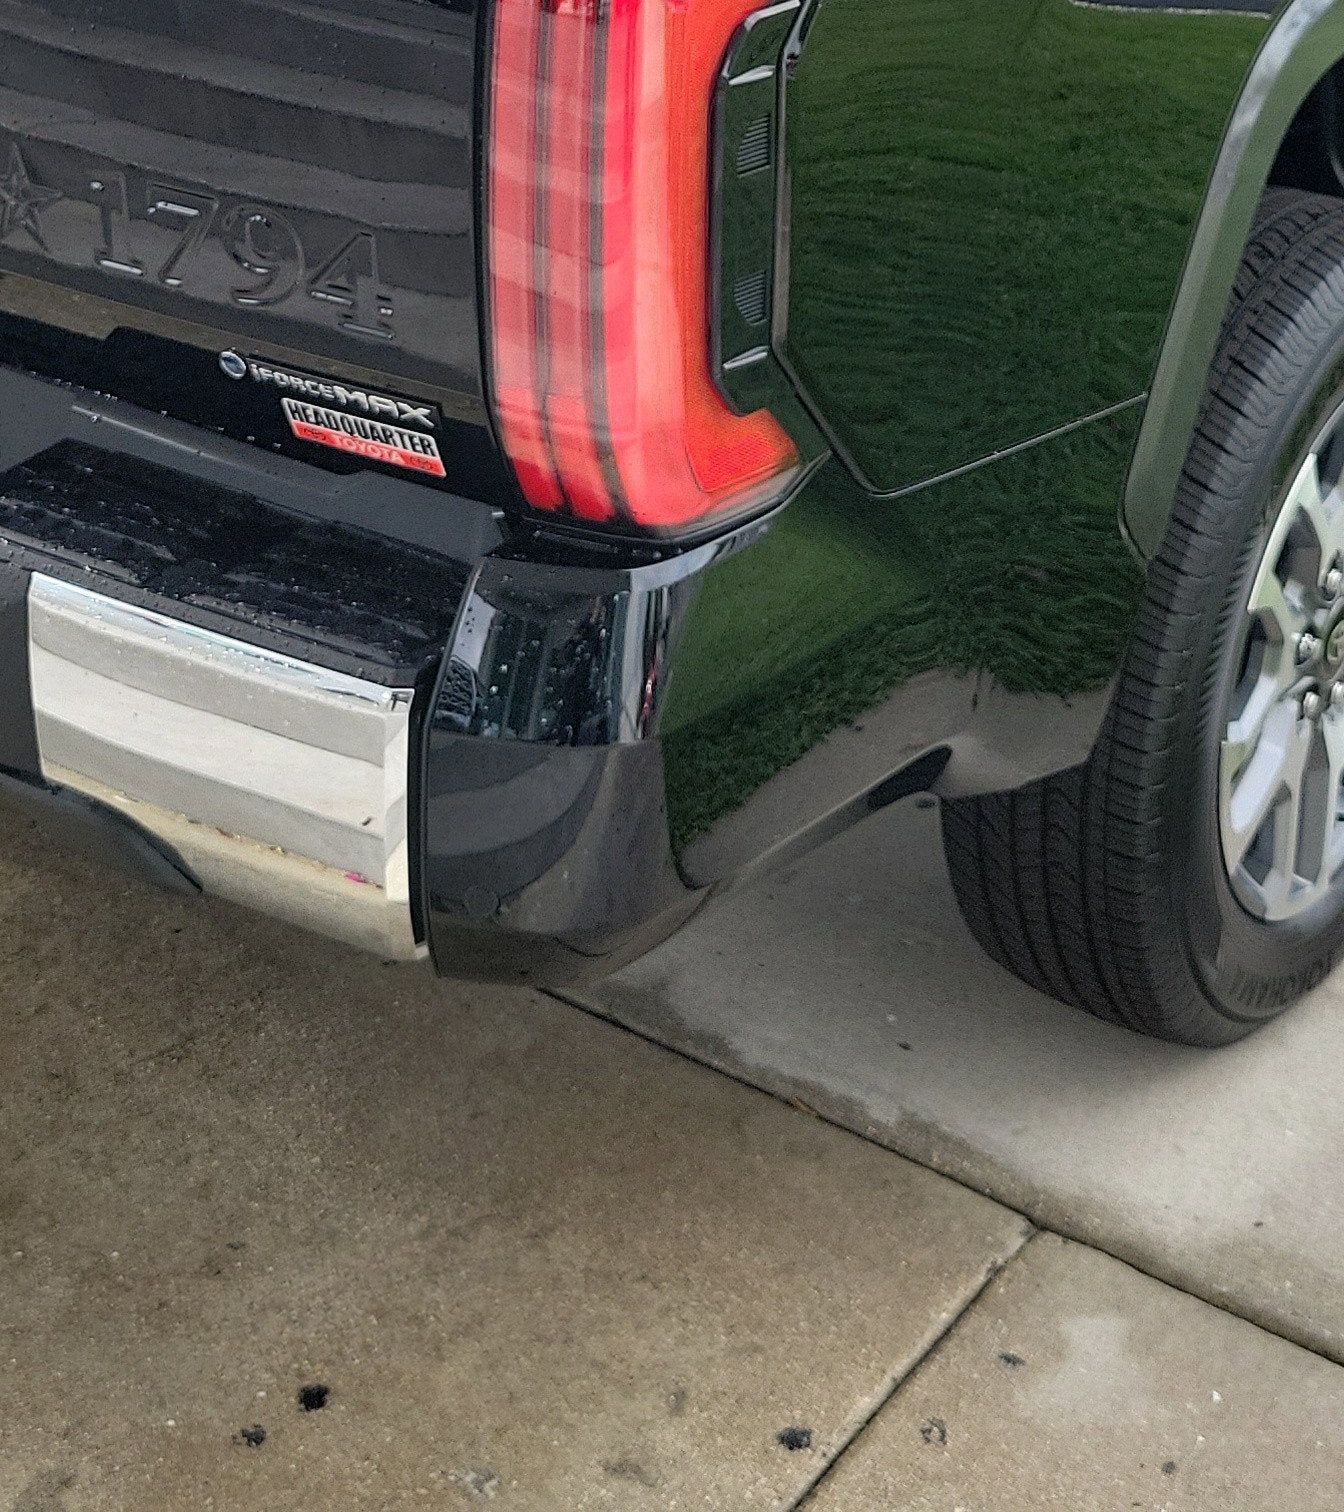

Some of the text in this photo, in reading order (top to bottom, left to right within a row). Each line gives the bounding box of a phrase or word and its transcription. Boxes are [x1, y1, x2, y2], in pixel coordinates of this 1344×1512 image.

[90, 171, 396, 339] 1794
[287, 400, 438, 456] HEADQUARTER
[331, 435, 406, 464] TOYOTA
